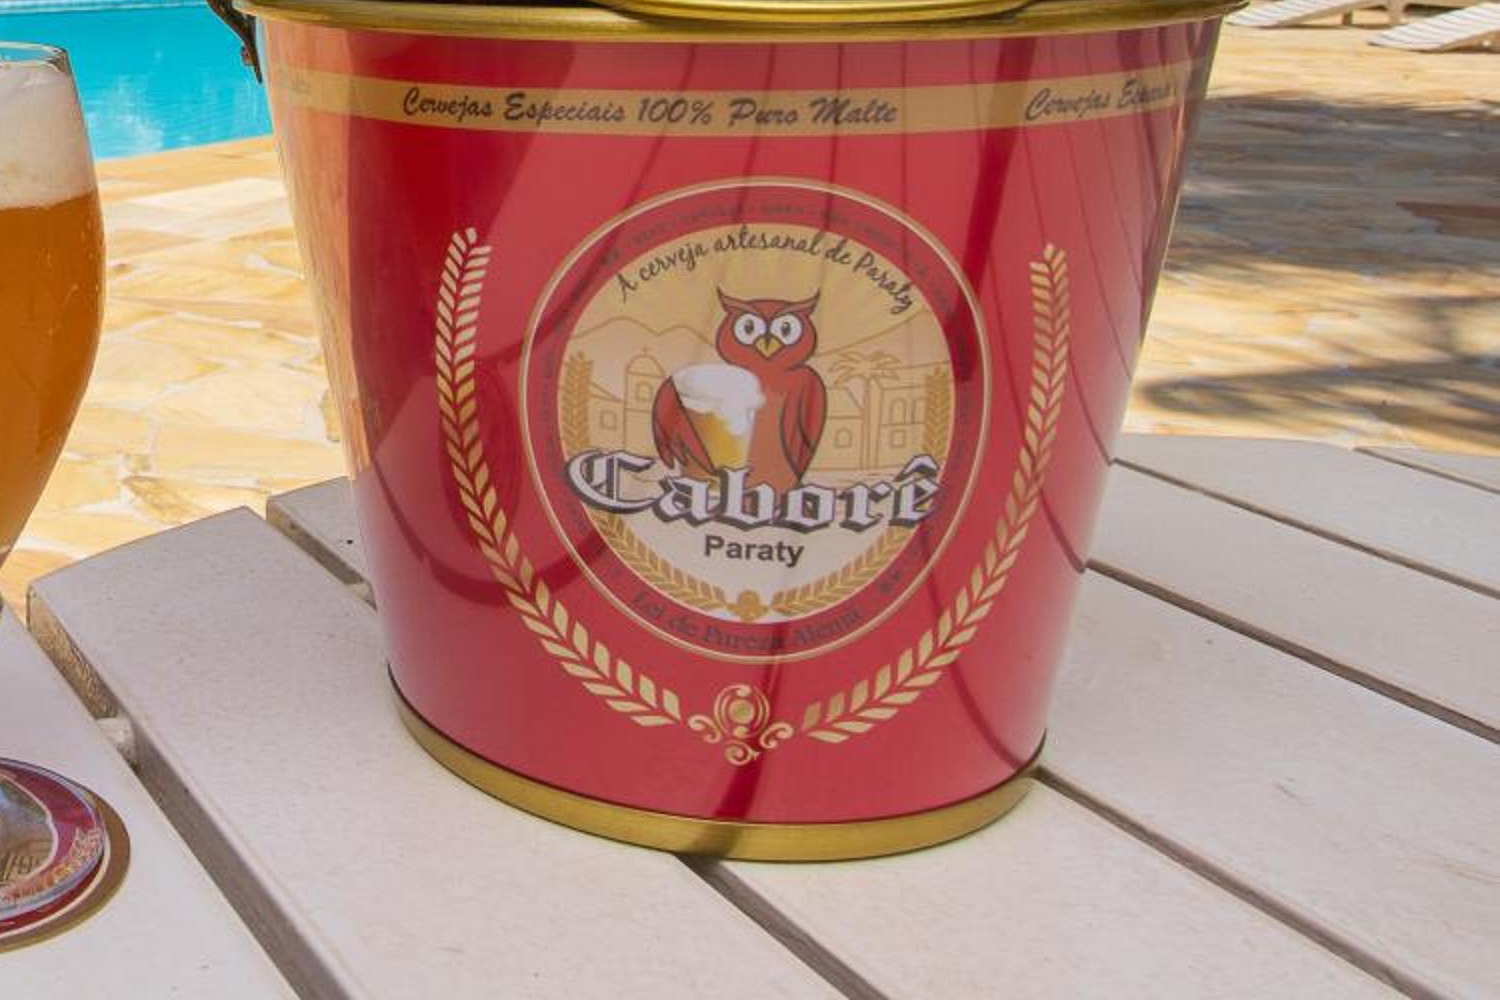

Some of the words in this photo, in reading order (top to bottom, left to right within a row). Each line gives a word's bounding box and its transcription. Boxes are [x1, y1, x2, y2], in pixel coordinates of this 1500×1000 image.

[403, 87, 494, 122] Cervejas
[503, 92, 625, 125] Especiais
[637, 97, 712, 125] 100%
[728, 96, 798, 127] Puro
[809, 96, 899, 125] Malte
[616, 273, 637, 303] A
[639, 243, 708, 272] cerveja
[713, 225, 821, 255] artesanal
[825, 238, 851, 265] de
[853, 251, 915, 315] Paraty
[564, 450, 942, 533] Caborê
[704, 535, 805, 568] Paraty
